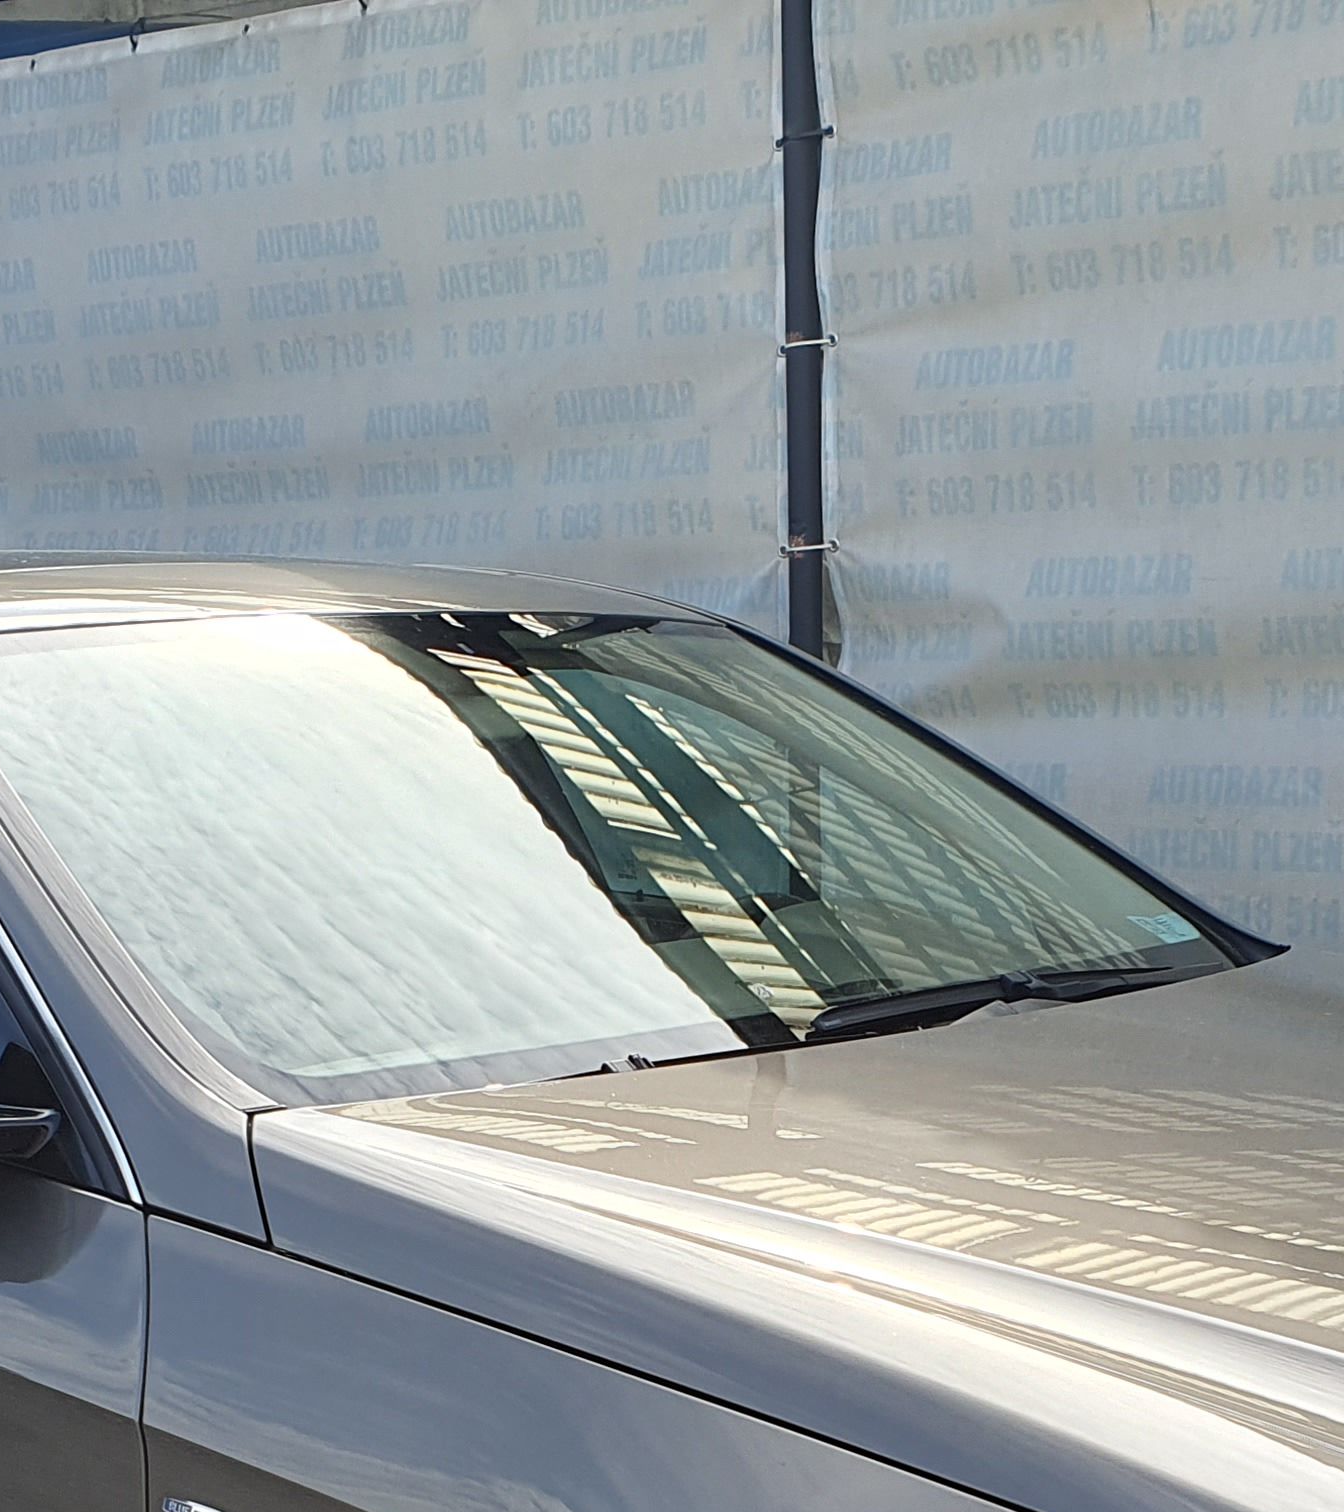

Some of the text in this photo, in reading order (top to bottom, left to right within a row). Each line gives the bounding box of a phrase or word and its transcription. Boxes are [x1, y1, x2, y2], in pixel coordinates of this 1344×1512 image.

[416, 49, 486, 102] PLZEŇ
[519, 16, 707, 89] JATEČNÍ PLZEŇ
[548, 105, 592, 146] 603
[605, 98, 648, 137] 718
[659, 90, 706, 131] 514
[1031, 97, 1202, 159] AUTOBAZAR
[168, 159, 202, 198] 603
[210, 154, 248, 192] 718
[256, 150, 294, 186] 514
[1008, 149, 1228, 229] JATEČNÍ PLZEŇ
[256, 214, 382, 264] AUTOBAZAR
[446, 191, 584, 242] AUTOBAZAR
[536, 234, 608, 290] PLZEŇ
[1049, 249, 1100, 291] 603
[1112, 241, 1160, 285] 718
[1179, 234, 1235, 278] 514
[279, 338, 318, 373] 603
[327, 333, 366, 373] 718
[375, 327, 415, 366] 514
[468, 319, 506, 356] 603
[518, 314, 555, 352] 718
[564, 308, 604, 347] 514
[1157, 316, 1337, 371] AUTOBAZAR
[915, 339, 1076, 389] AUTOBAZAR
[561, 503, 601, 540] 603
[615, 500, 654, 536] 718
[669, 497, 712, 534] 514
[927, 475, 975, 515] 603
[986, 472, 1034, 512] 718
[1048, 471, 1097, 509] 514
[1024, 554, 1193, 597] AUTOBAZAR
[1002, 608, 1218, 661] JATEČNÍ PLZEŇ
[1043, 682, 1096, 718] 603
[1106, 681, 1161, 718] 718
[1173, 681, 1226, 719] 514
